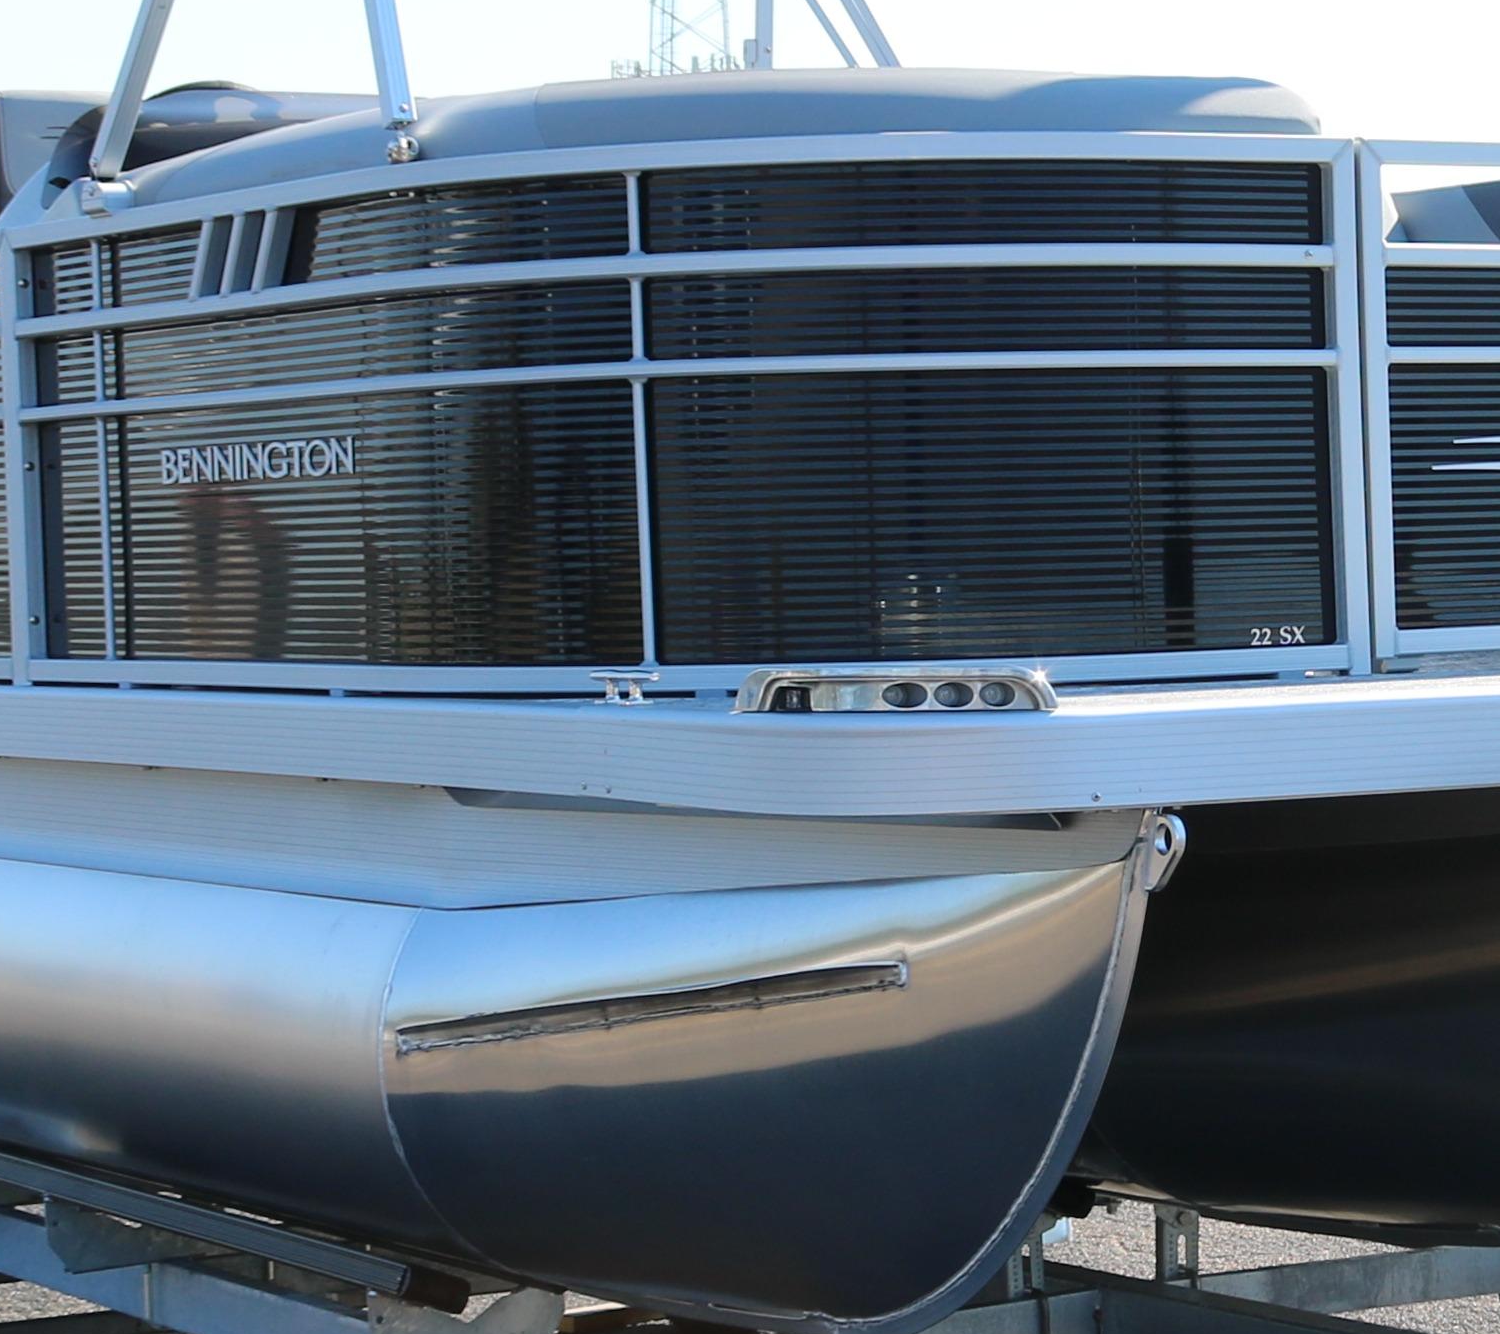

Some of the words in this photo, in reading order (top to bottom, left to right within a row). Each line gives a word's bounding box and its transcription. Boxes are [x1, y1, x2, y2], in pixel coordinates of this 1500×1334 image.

[160, 435, 355, 485] BENNINGTON
[1250, 627, 1272, 646] 22
[1280, 625, 1306, 645] SX
